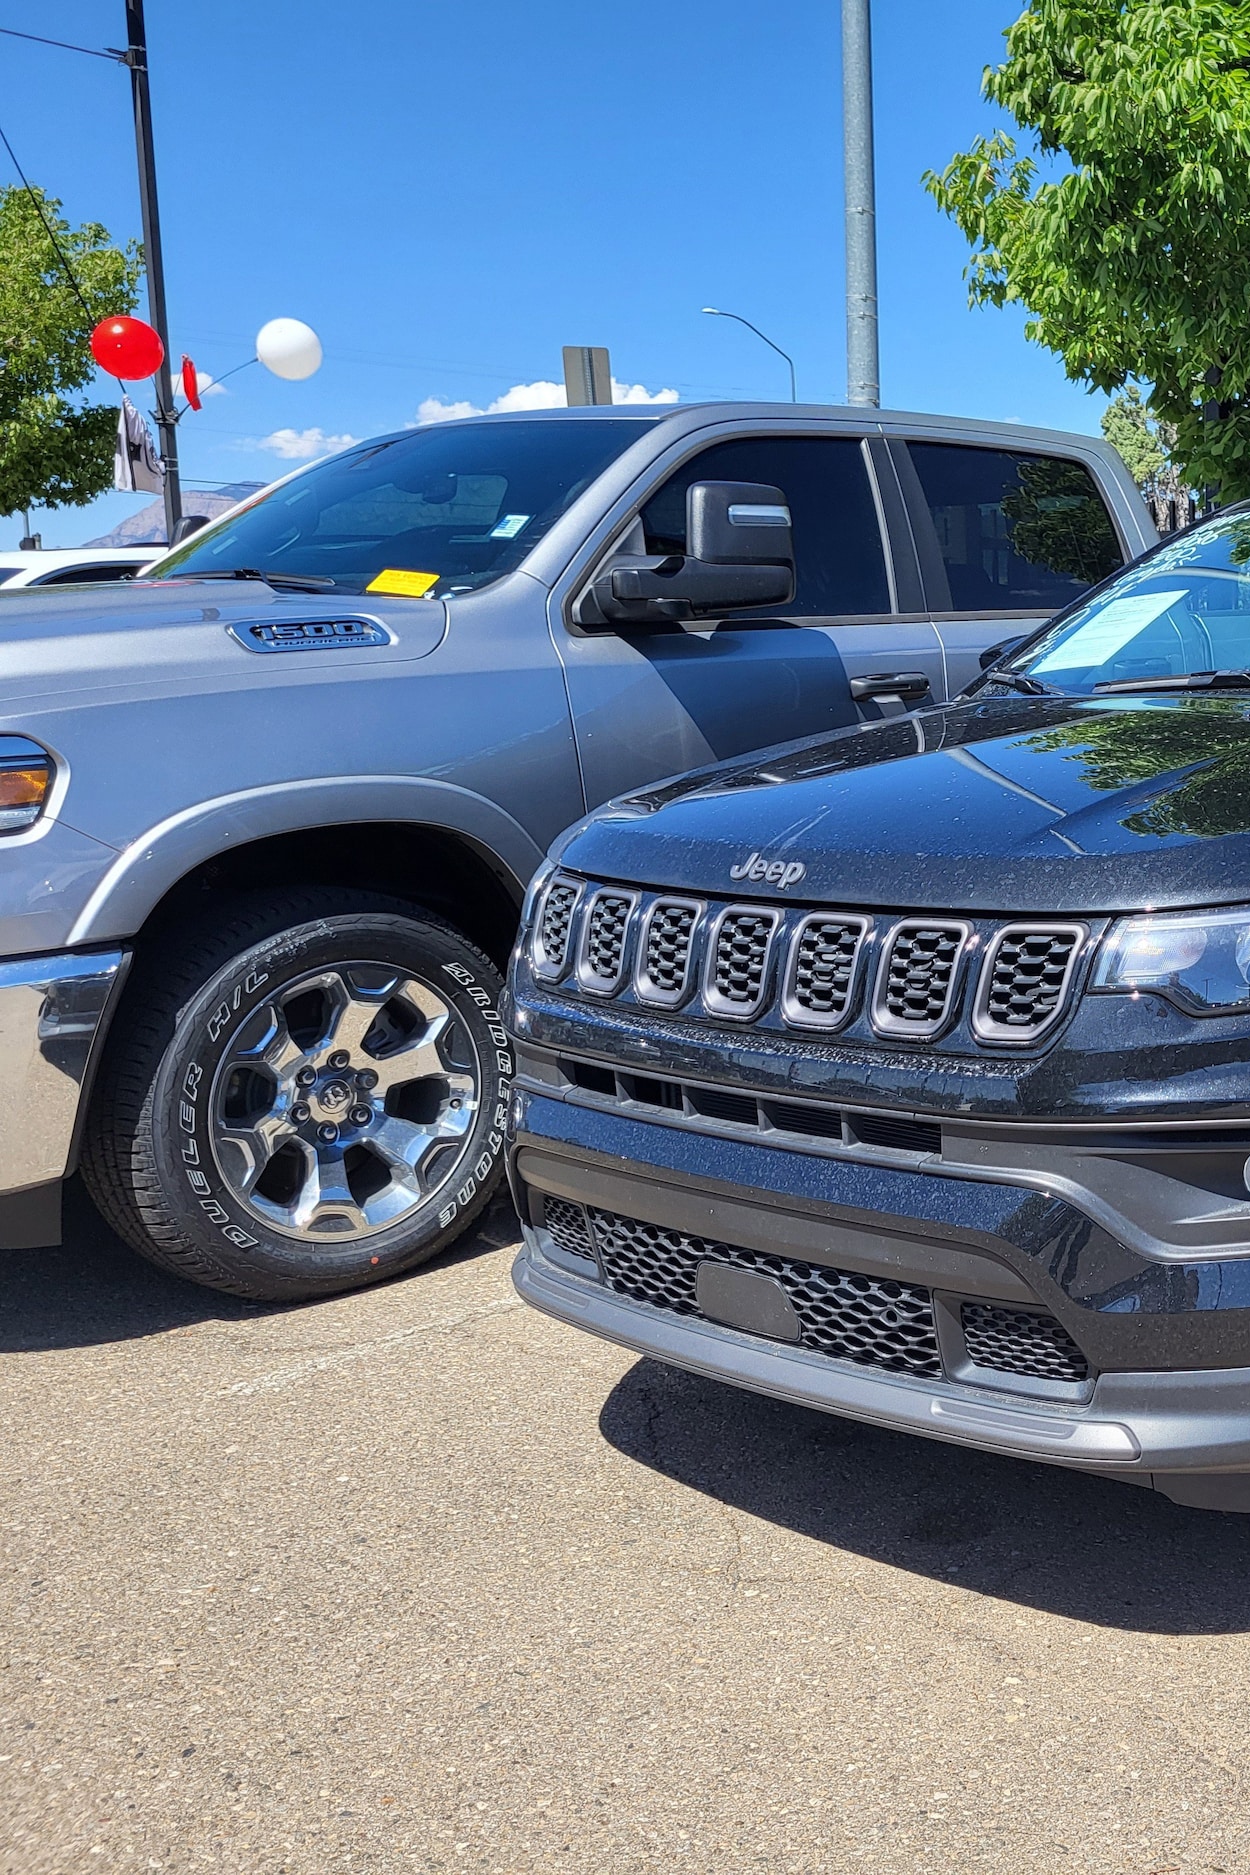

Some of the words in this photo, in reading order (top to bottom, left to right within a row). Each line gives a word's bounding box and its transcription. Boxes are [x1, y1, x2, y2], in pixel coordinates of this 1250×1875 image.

[254, 621, 364, 641] 1500
[729, 852, 806, 890] Jeep
[439, 961, 512, 1229] BRIDGESTONE
[179, 1061, 259, 1250] DUELER
